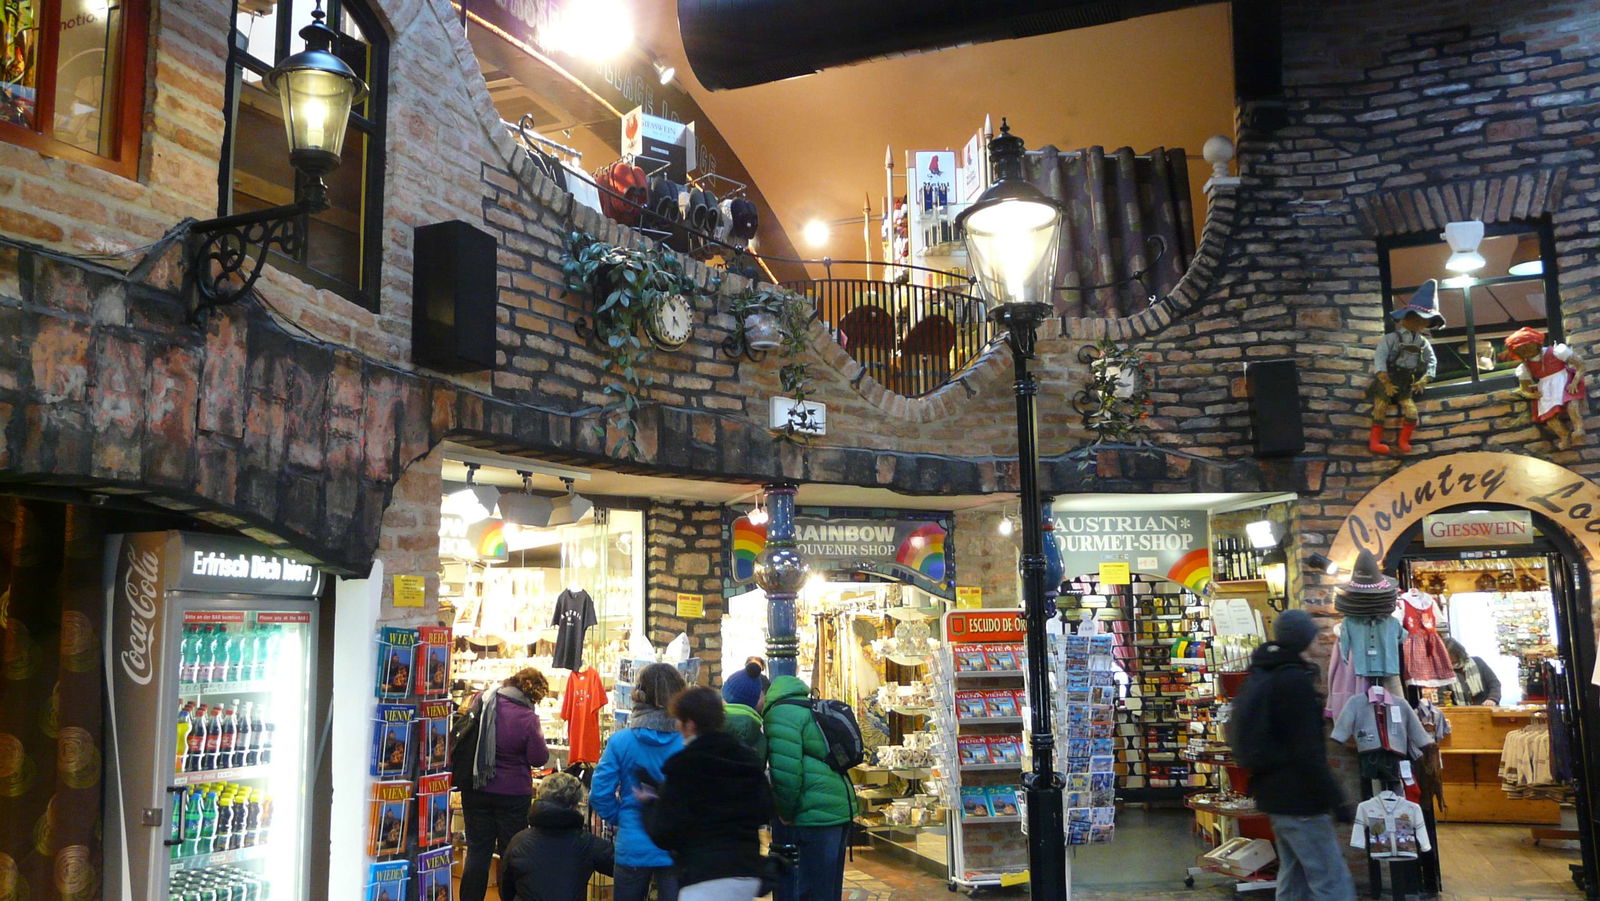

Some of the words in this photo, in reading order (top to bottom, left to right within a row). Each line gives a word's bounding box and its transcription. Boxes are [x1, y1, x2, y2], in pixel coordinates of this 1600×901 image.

[1349, 463, 1507, 562] Country
[797, 543, 858, 556] OUVENIR
[860, 544, 896, 557] SHOP
[1055, 533, 1194, 552] OURMET-SHOP
[192, 551, 250, 579] Erfrisch
[250, 554, 283, 580] Dich
[282, 557, 313, 582] hier!
[969, 618, 1001, 633] ESCUDO
[1002, 618, 1013, 632] DE
[1014, 617, 1027, 632] OR
[389, 632, 415, 645] WIEN
